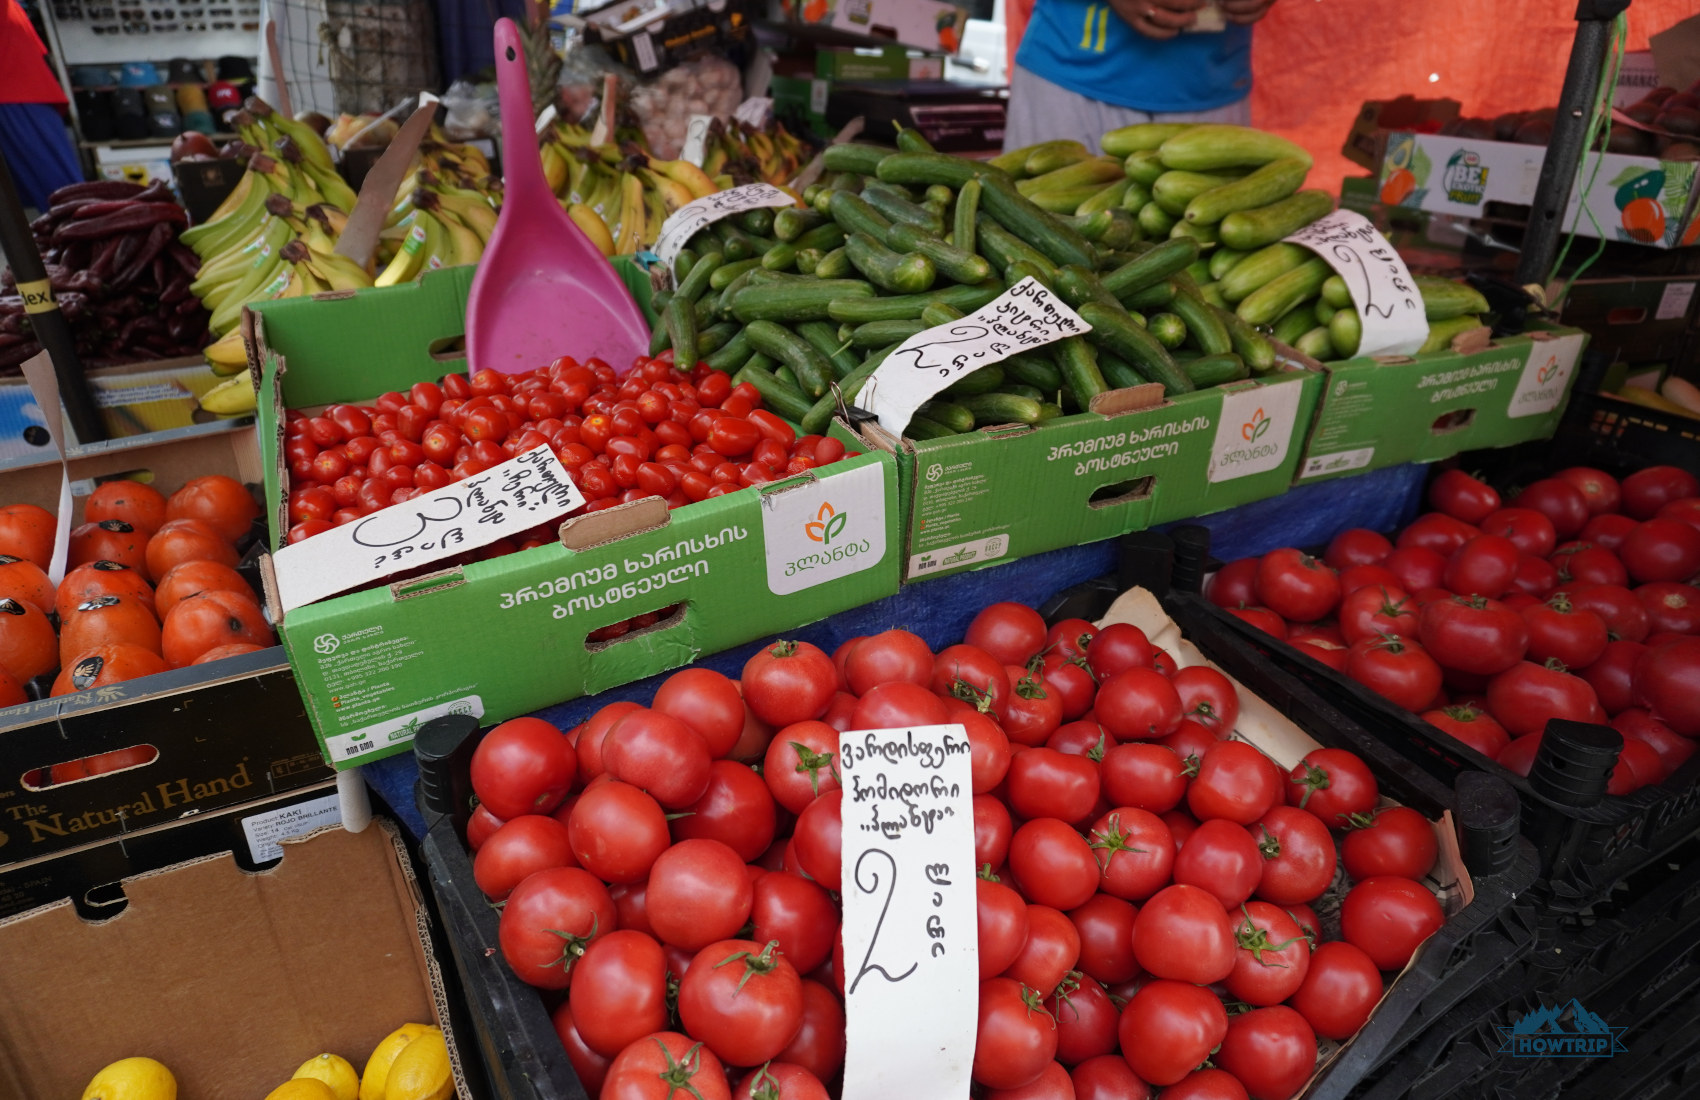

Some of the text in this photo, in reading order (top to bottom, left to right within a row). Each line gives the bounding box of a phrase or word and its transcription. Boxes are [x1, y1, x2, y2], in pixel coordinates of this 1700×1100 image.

[1333, 244, 1395, 319] 2
[996, 302, 1050, 336] კიტრი
[1010, 281, 1081, 333] ქართული
[895, 326, 989, 368] 2
[1047, 417, 1210, 462] პრემიუმ ხარისხის
[1075, 441, 1179, 476] ბოსტნეული
[1220, 442, 1278, 467] პლანტა
[517, 448, 571, 507] ქართული
[466, 476, 509, 524] პლანტა
[499, 525, 748, 609] პრემიუმ ხარისხის
[784, 539, 870, 577] პლანტა
[552, 560, 709, 620] ბოსტნეული
[371, 682, 390, 691] Planta
[346, 740, 374, 756] NON GMO
[389, 727, 414, 741] NATURAL
[841, 731, 971, 769] ვარდისფერი
[23, 793, 153, 844] Natural
[155, 762, 253, 810] Hand
[853, 773, 960, 806] პომიდორი
[6, 802, 48, 822] The
[276, 818, 295, 827] ROJO
[298, 806, 338, 821] BRILLANTE
[280, 809, 302, 820] KAKI
[848, 848, 919, 994] 2
[925, 863, 952, 958] ლარი
